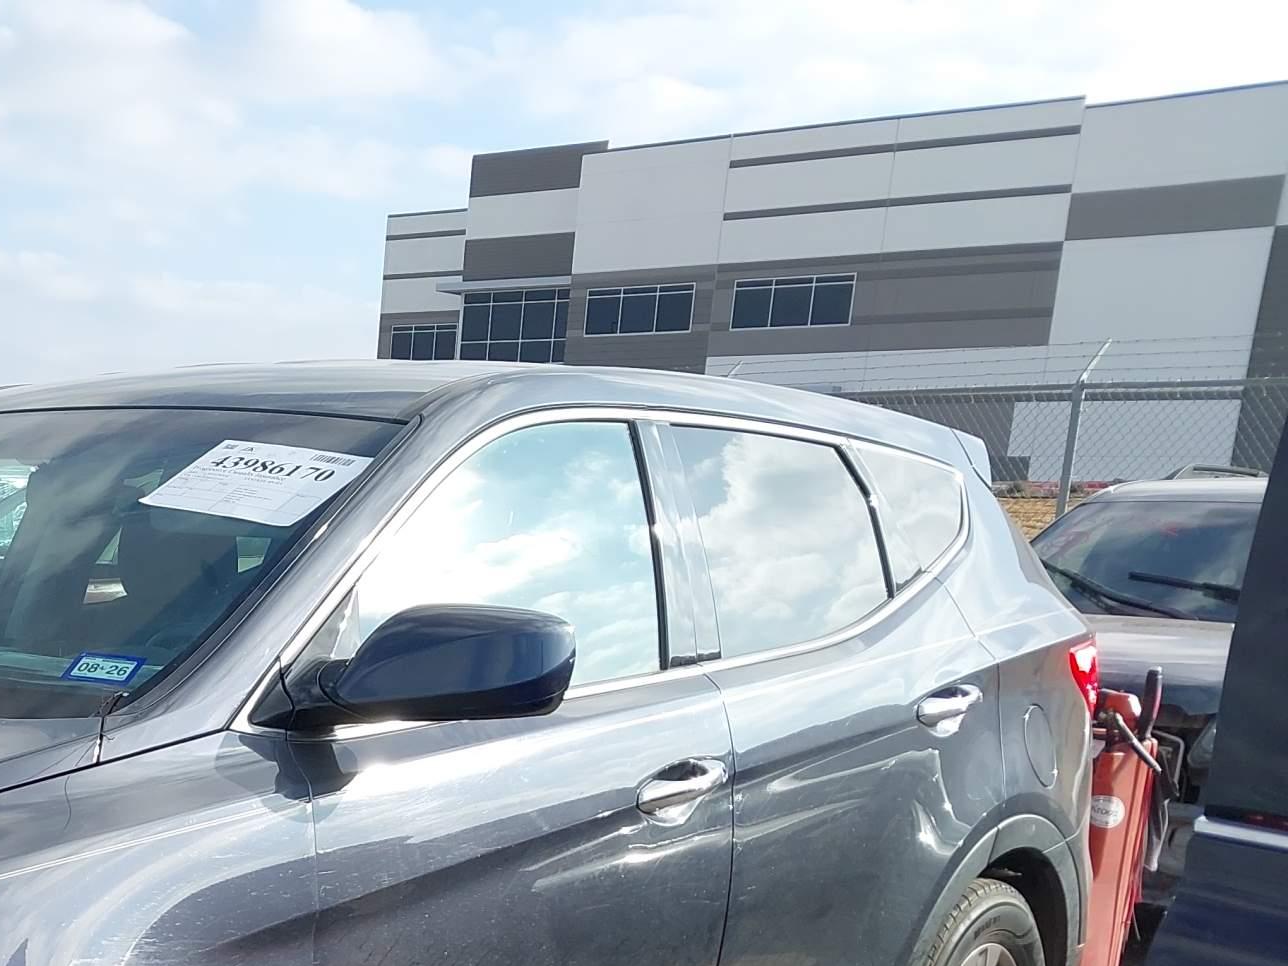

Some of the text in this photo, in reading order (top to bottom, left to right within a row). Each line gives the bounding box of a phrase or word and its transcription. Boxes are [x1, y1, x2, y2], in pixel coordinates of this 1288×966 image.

[210, 455, 336, 482] 43986170
[77, 662, 130, 676] 08 26
